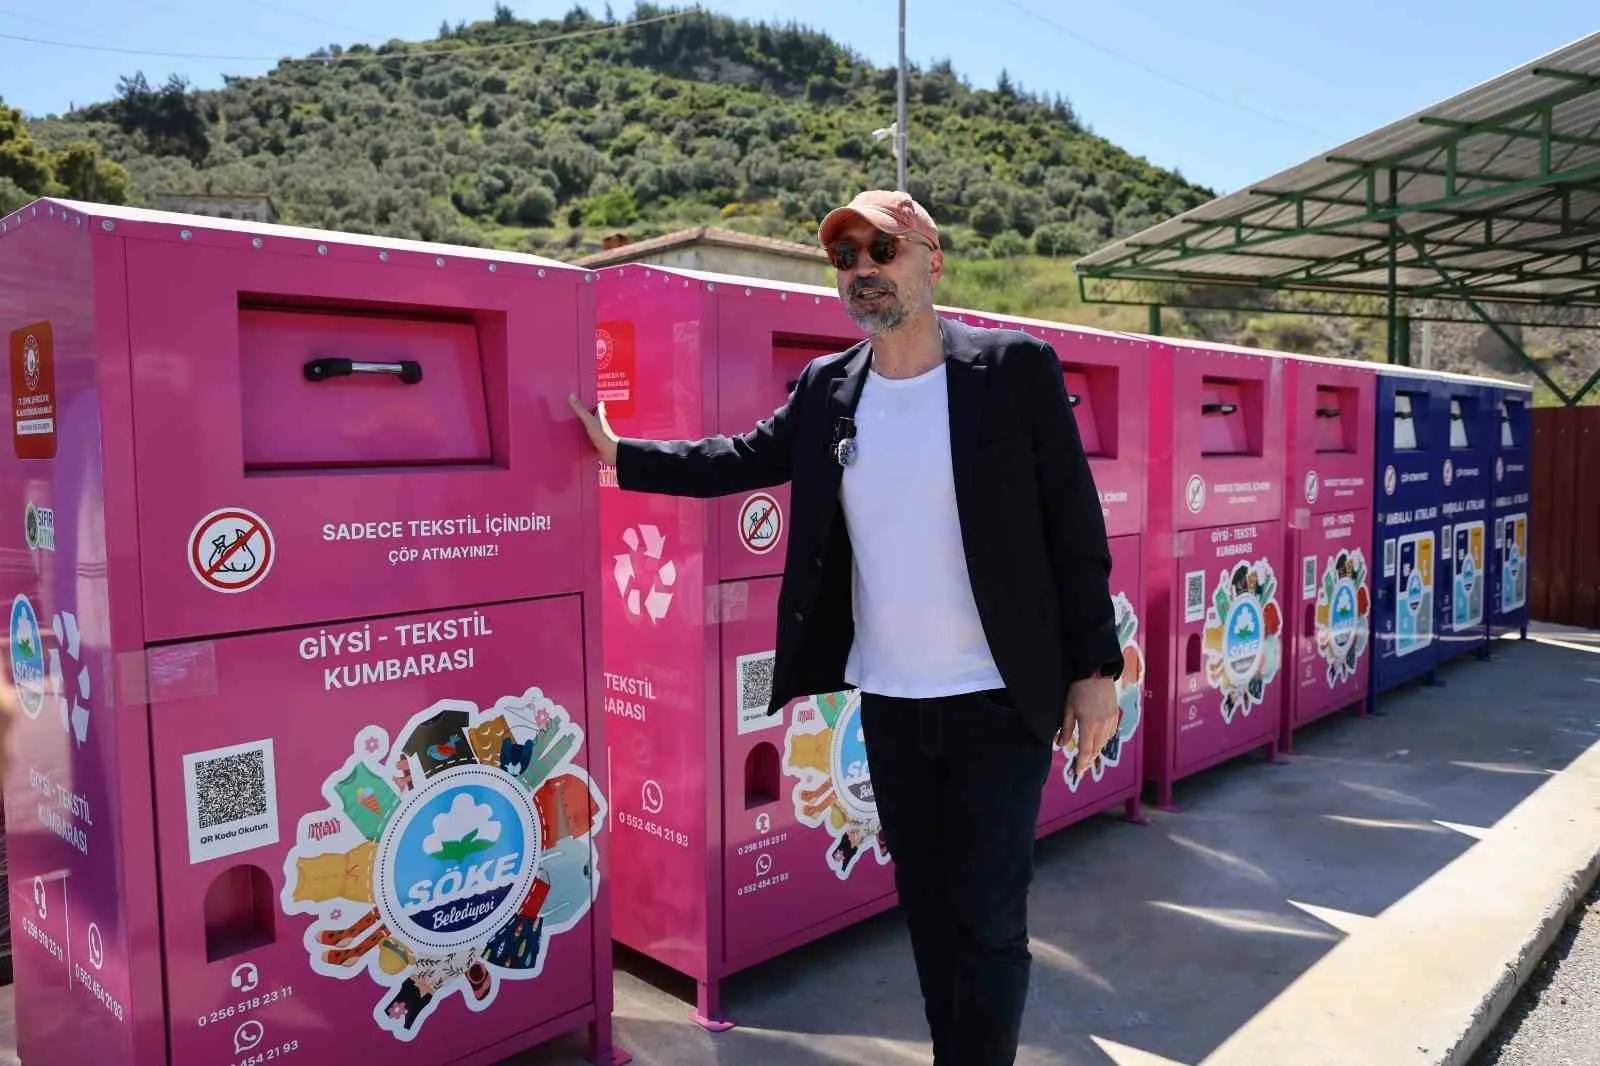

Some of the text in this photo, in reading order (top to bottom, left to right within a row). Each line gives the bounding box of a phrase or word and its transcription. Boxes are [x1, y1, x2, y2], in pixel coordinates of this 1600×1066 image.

[322, 512, 551, 541] SADECE TEKSTİL İÇİNDİR!
[388, 544, 499, 566] ÇÖP ATMAYINIZ!
[298, 624, 371, 660] GİYSİ
[395, 611, 493, 646] TEKSTİL
[324, 647, 475, 690] KUMBARASI
[603, 672, 657, 700] TEKSTİL
[604, 695, 646, 722] ARASI
[200, 823, 269, 845] QR Kodu Okutun
[618, 811, 689, 848] 0 552 454 21 93
[404, 851, 521, 908] SÖKE
[432, 895, 496, 929] Belediyesi
[198, 985, 293, 1027] 0 256 518 23 11
[240, 1039, 298, 1066] 454 21 93
